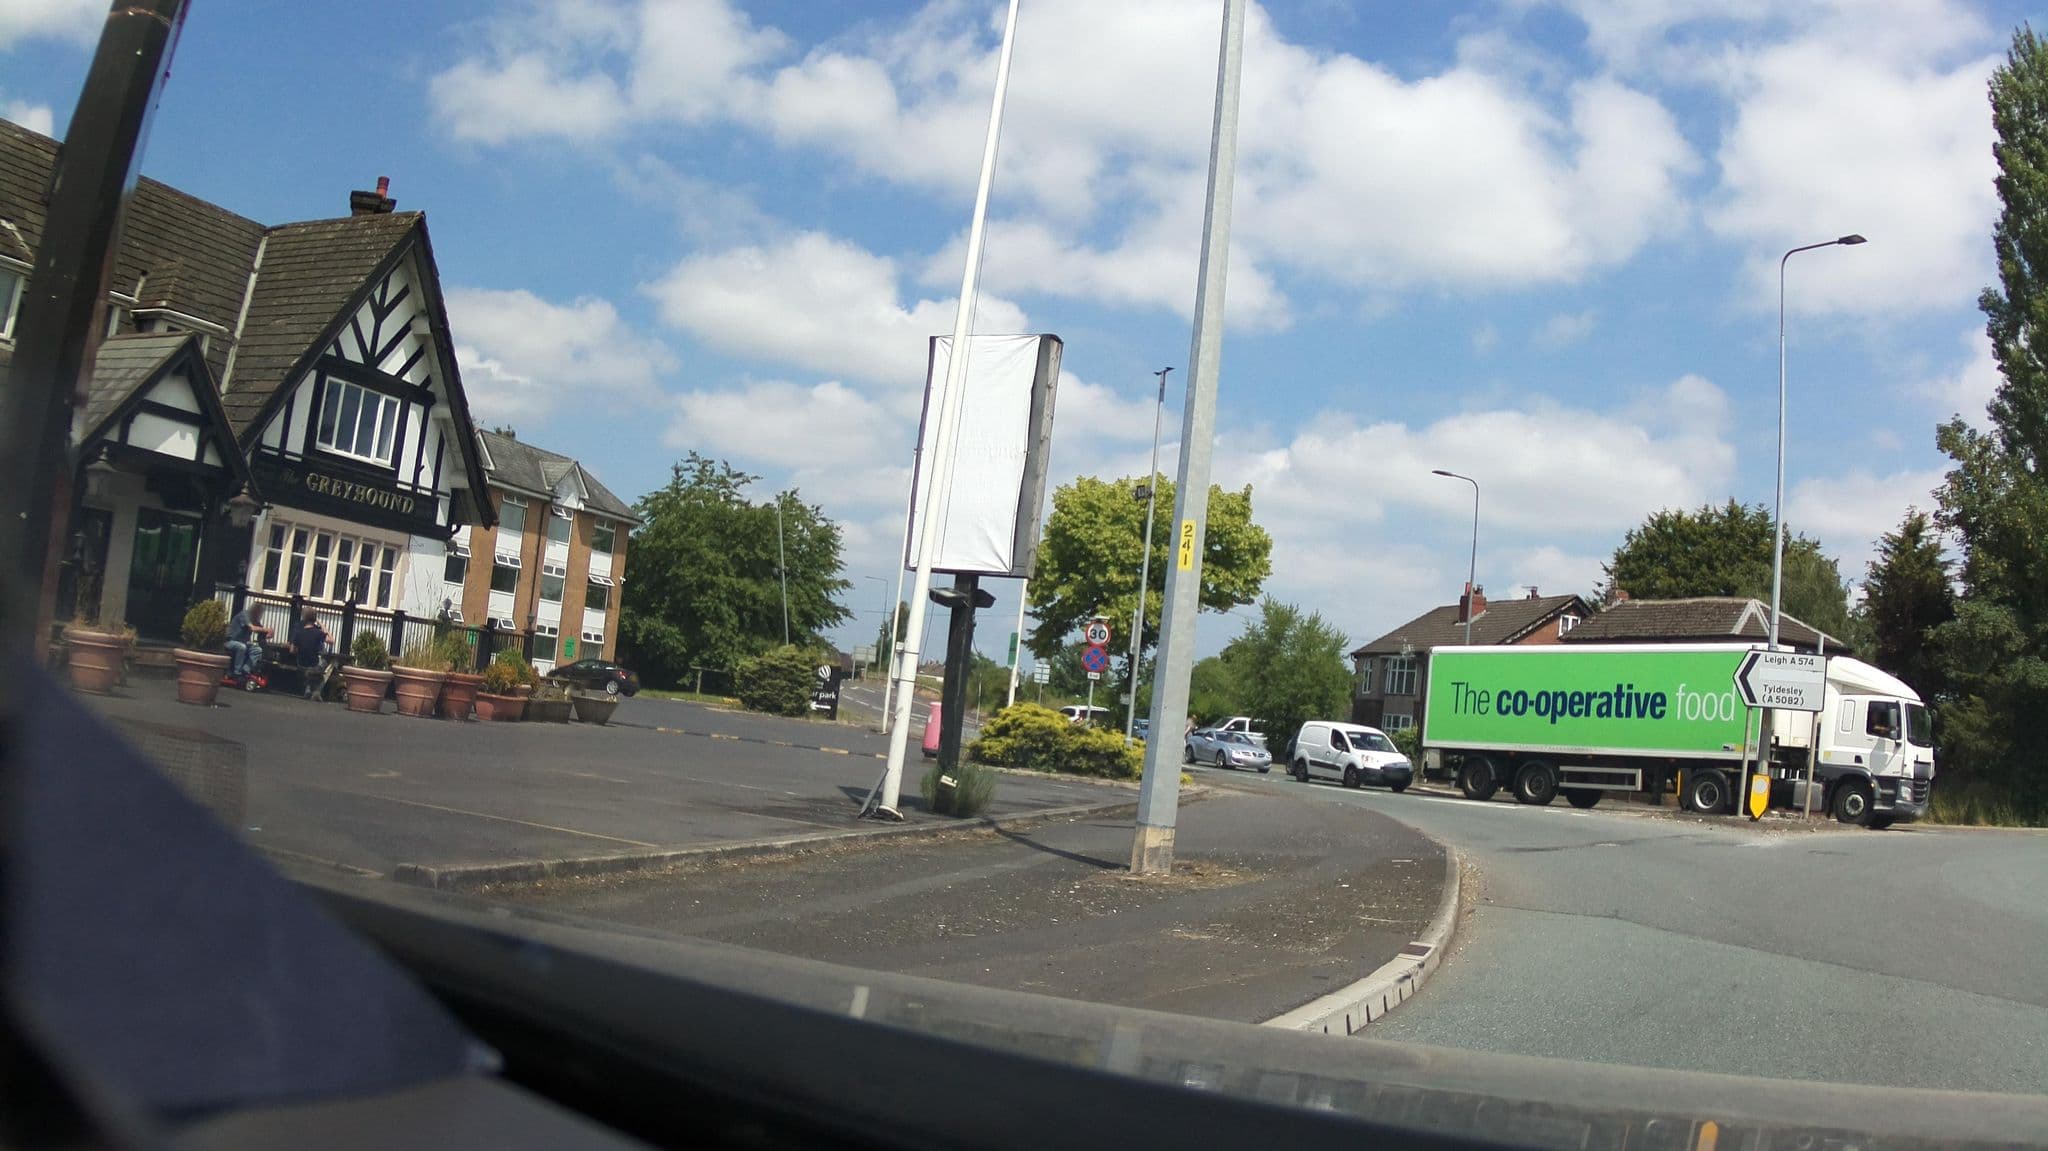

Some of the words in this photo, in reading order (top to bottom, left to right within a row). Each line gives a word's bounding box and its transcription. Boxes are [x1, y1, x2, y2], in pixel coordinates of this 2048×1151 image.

[306, 472, 415, 514] GREYHOUND
[1182, 524, 1193, 566] 241
[1089, 629, 1107, 640] 30
[1764, 654, 1788, 665] Leigh
[819, 691, 837, 700] park
[1763, 684, 1804, 697] Tyldesley
[1451, 682, 1490, 715] The
[1496, 683, 1667, 724] co-operative
[1675, 684, 1737, 721] food
